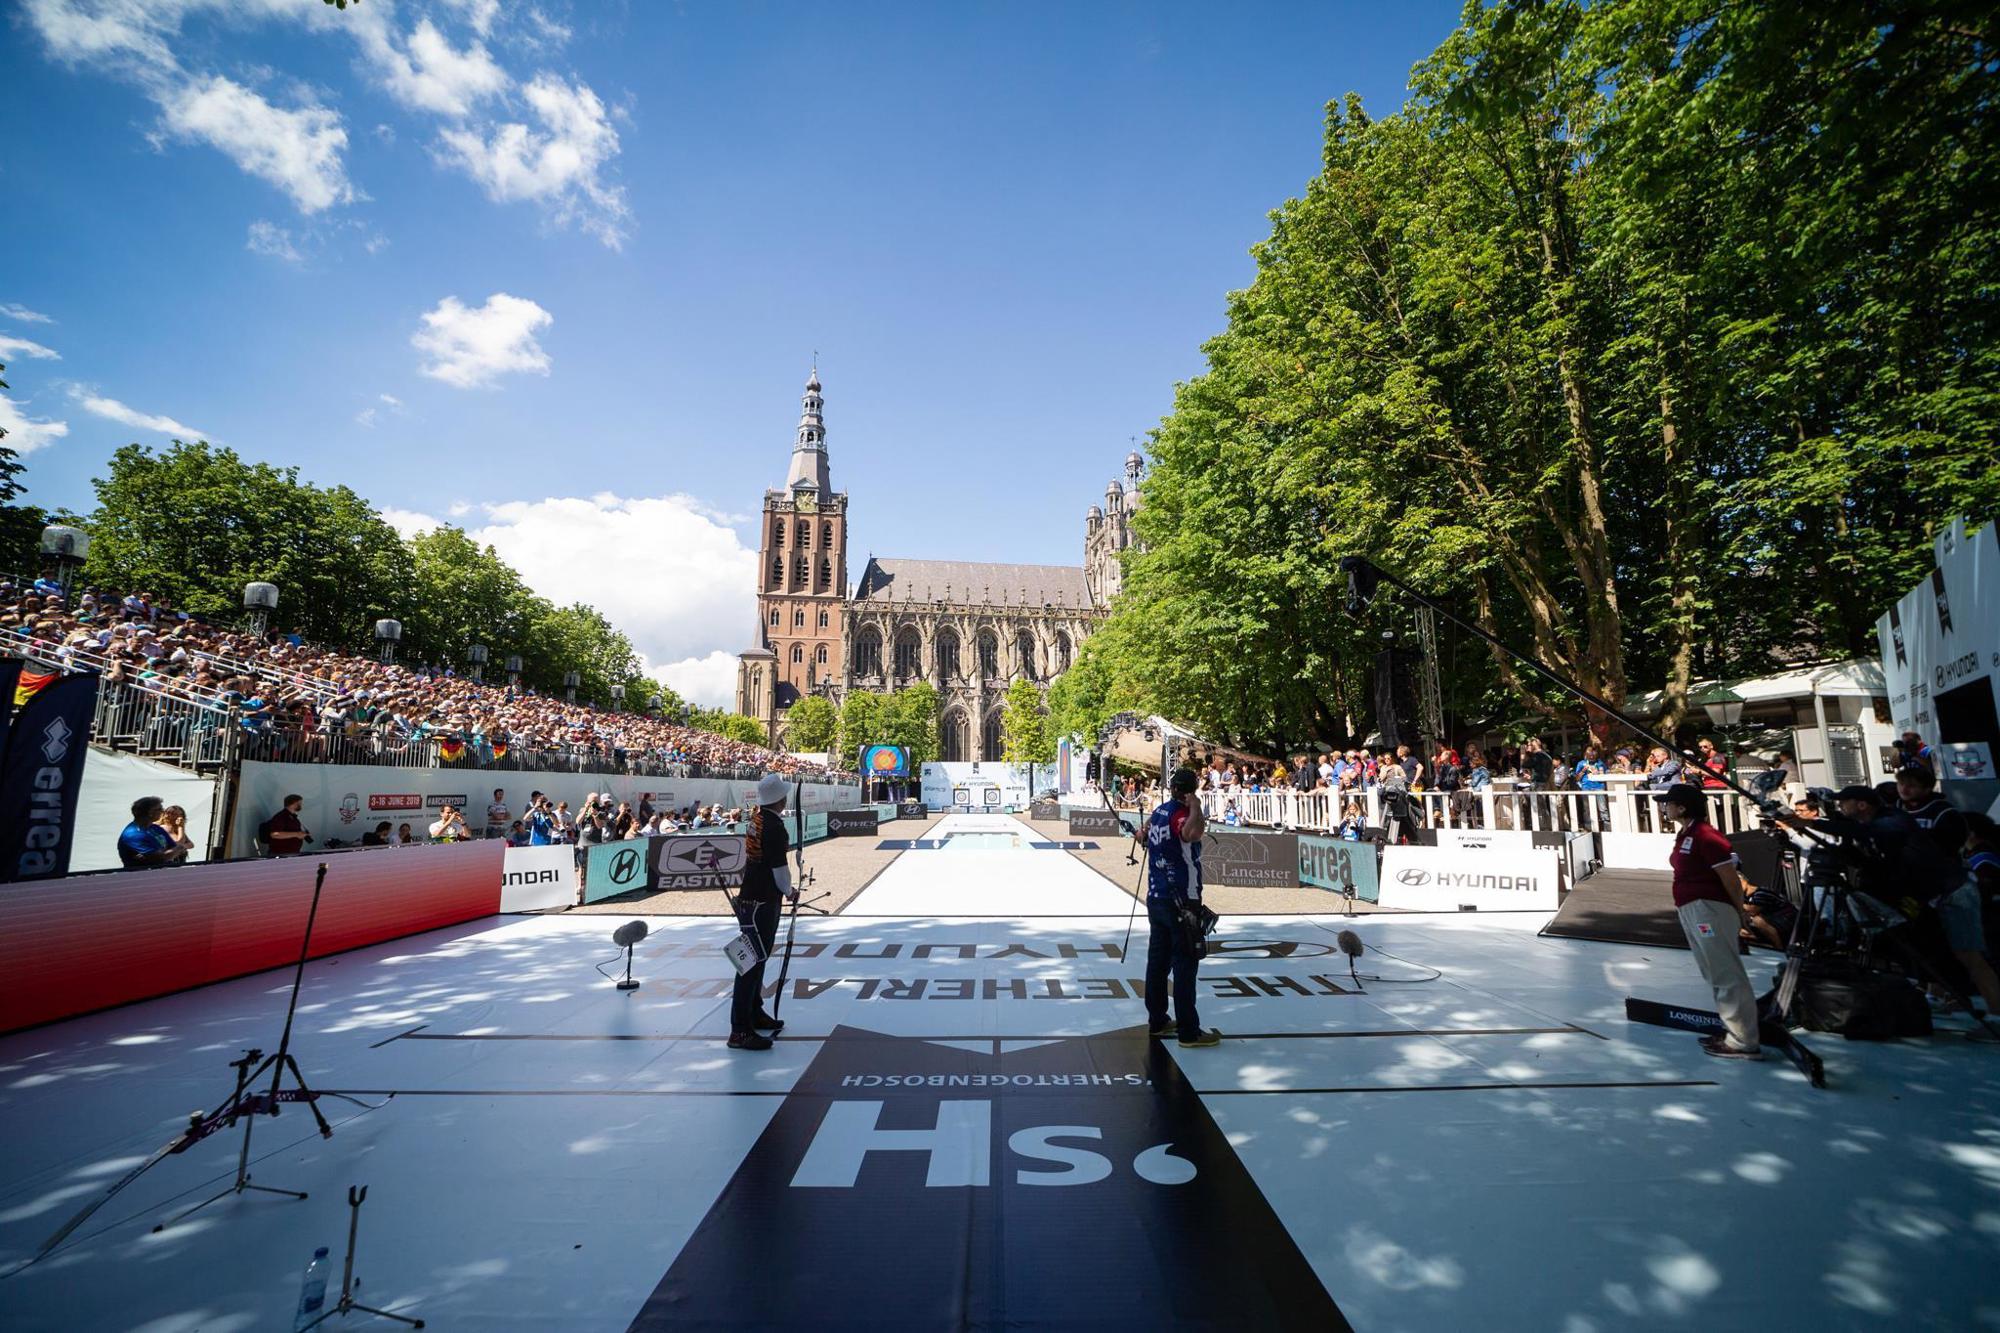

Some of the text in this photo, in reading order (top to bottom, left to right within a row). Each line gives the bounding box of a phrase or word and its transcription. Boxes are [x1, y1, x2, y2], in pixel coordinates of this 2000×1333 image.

[1945, 651, 1979, 682] HYUNDAI
[388, 797, 405, 806] JUNE
[406, 796, 420, 805] 2019
[1071, 816, 1117, 827] HOYT
[1222, 863, 1291, 880] Lancaster
[1221, 878, 1289, 887] ARCHERY SUPPLY
[1437, 872, 1538, 892] HYUNDAI
[737, 950, 748, 961] 16
[1199, 975, 1368, 998] THE
